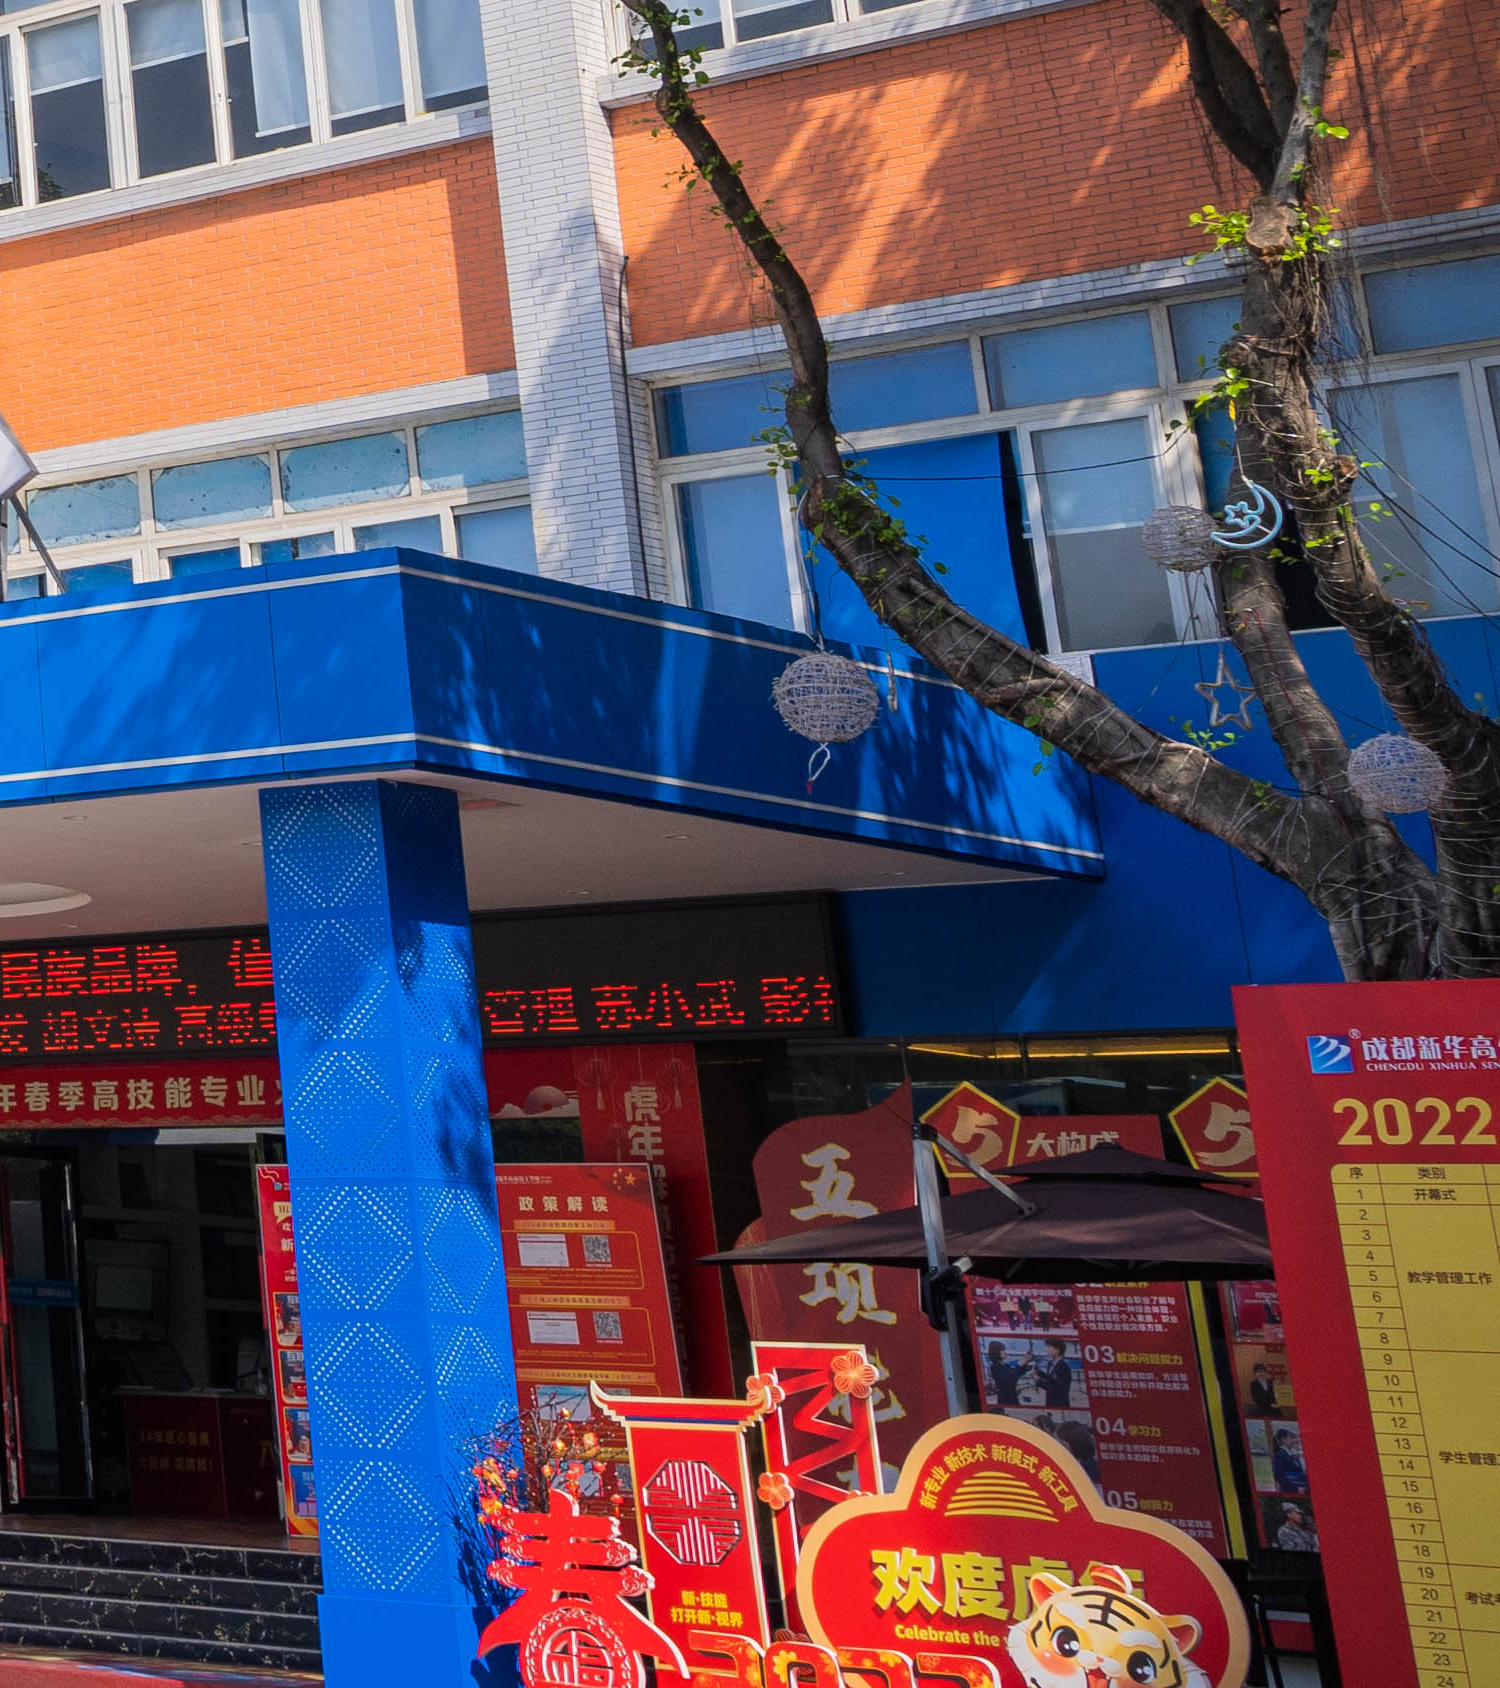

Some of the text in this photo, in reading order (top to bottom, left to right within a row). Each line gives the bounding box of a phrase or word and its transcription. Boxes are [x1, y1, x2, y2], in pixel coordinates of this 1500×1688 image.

[1361, 1034, 1500, 1061] 成都新华高
[1366, 1062, 1425, 1072] CHENGDU
[1429, 1061, 1477, 1070] XINHUA
[1333, 1096, 1497, 1146] 2022
[1349, 1166, 1446, 1180] 序 类别
[1414, 1188, 1457, 1201] 开幕式
[518, 1195, 609, 1212] 政策解读
[1359, 1209, 1367, 1220] 2
[1362, 1229, 1371, 1241] 3
[1366, 1250, 1374, 1261] 4
[1369, 1270, 1493, 1286] 5 教学管理工作
[1372, 1291, 1382, 1303] 6
[1376, 1312, 1384, 1323] 7
[1380, 1333, 1389, 1344] 8
[1084, 1344, 1184, 1366] 03 解决问题能力
[1383, 1354, 1392, 1365] 9
[1384, 1375, 1400, 1386] 10
[1388, 1396, 1404, 1408] 11
[1096, 1417, 1162, 1438] 04 学习力
[1390, 1417, 1406, 1429] 12
[1394, 1438, 1411, 1450] 13
[1398, 1450, 1500, 1471] 14 学生管理
[919, 1443, 1078, 1514] 新专业 新技术 新模式 新工具
[1402, 1480, 1419, 1492] 15
[1106, 1490, 1139, 1510] 05
[1406, 1502, 1423, 1514] 16
[1410, 1523, 1426, 1535] 17
[1414, 1545, 1430, 1557] 18
[1417, 1566, 1434, 1579] 19
[1421, 1588, 1439, 1601] 20
[1425, 1610, 1442, 1622] 21
[894, 1624, 1001, 1646] Celebrate the
[1429, 1632, 1446, 1644] 22
[1433, 1653, 1450, 1666] 23
[1436, 1676, 1454, 1688] 24
